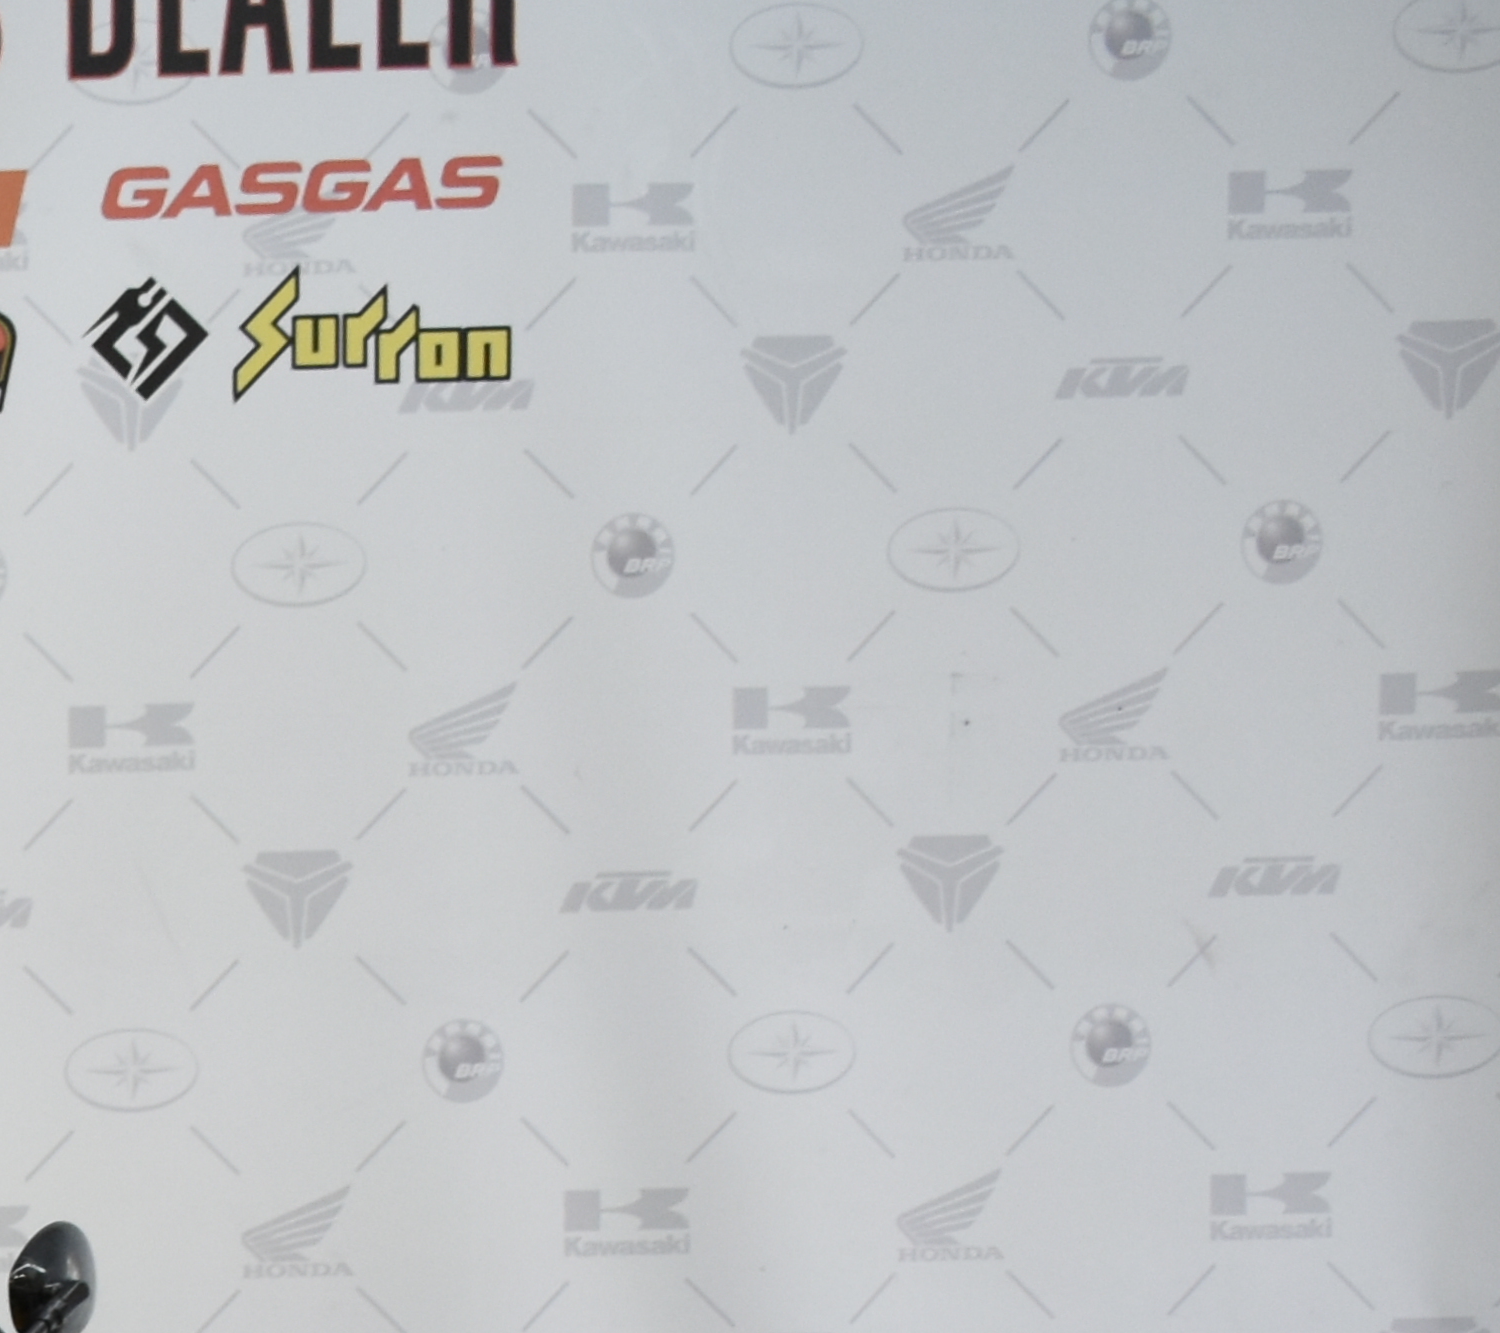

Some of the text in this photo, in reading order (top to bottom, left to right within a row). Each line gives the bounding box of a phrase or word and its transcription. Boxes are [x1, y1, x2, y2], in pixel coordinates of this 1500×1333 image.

[1121, 39, 1168, 56] BRP
[100, 154, 503, 222] GASGAS
[1227, 214, 1355, 240] Kawasaki
[571, 230, 697, 253] Kawasaki
[903, 244, 1015, 262] HONDA
[1055, 356, 1190, 399] KTM
[1272, 543, 1322, 560] BRP
[622, 557, 672, 574] BRP
[732, 732, 853, 755] Kawasaki
[1059, 745, 1170, 762] HONDA
[68, 749, 196, 774] Kawasaki
[409, 759, 520, 777] HONDA
[1208, 855, 1341, 897] KTM
[560, 870, 697, 913] KTM
[1101, 1046, 1151, 1063] BRP
[452, 1062, 502, 1079] BRP
[1210, 1217, 1333, 1241] Kawasaki
[565, 1231, 690, 1256] Kawasaki
[898, 1245, 1006, 1262] HONDA
[243, 1262, 356, 1279] HONDA
